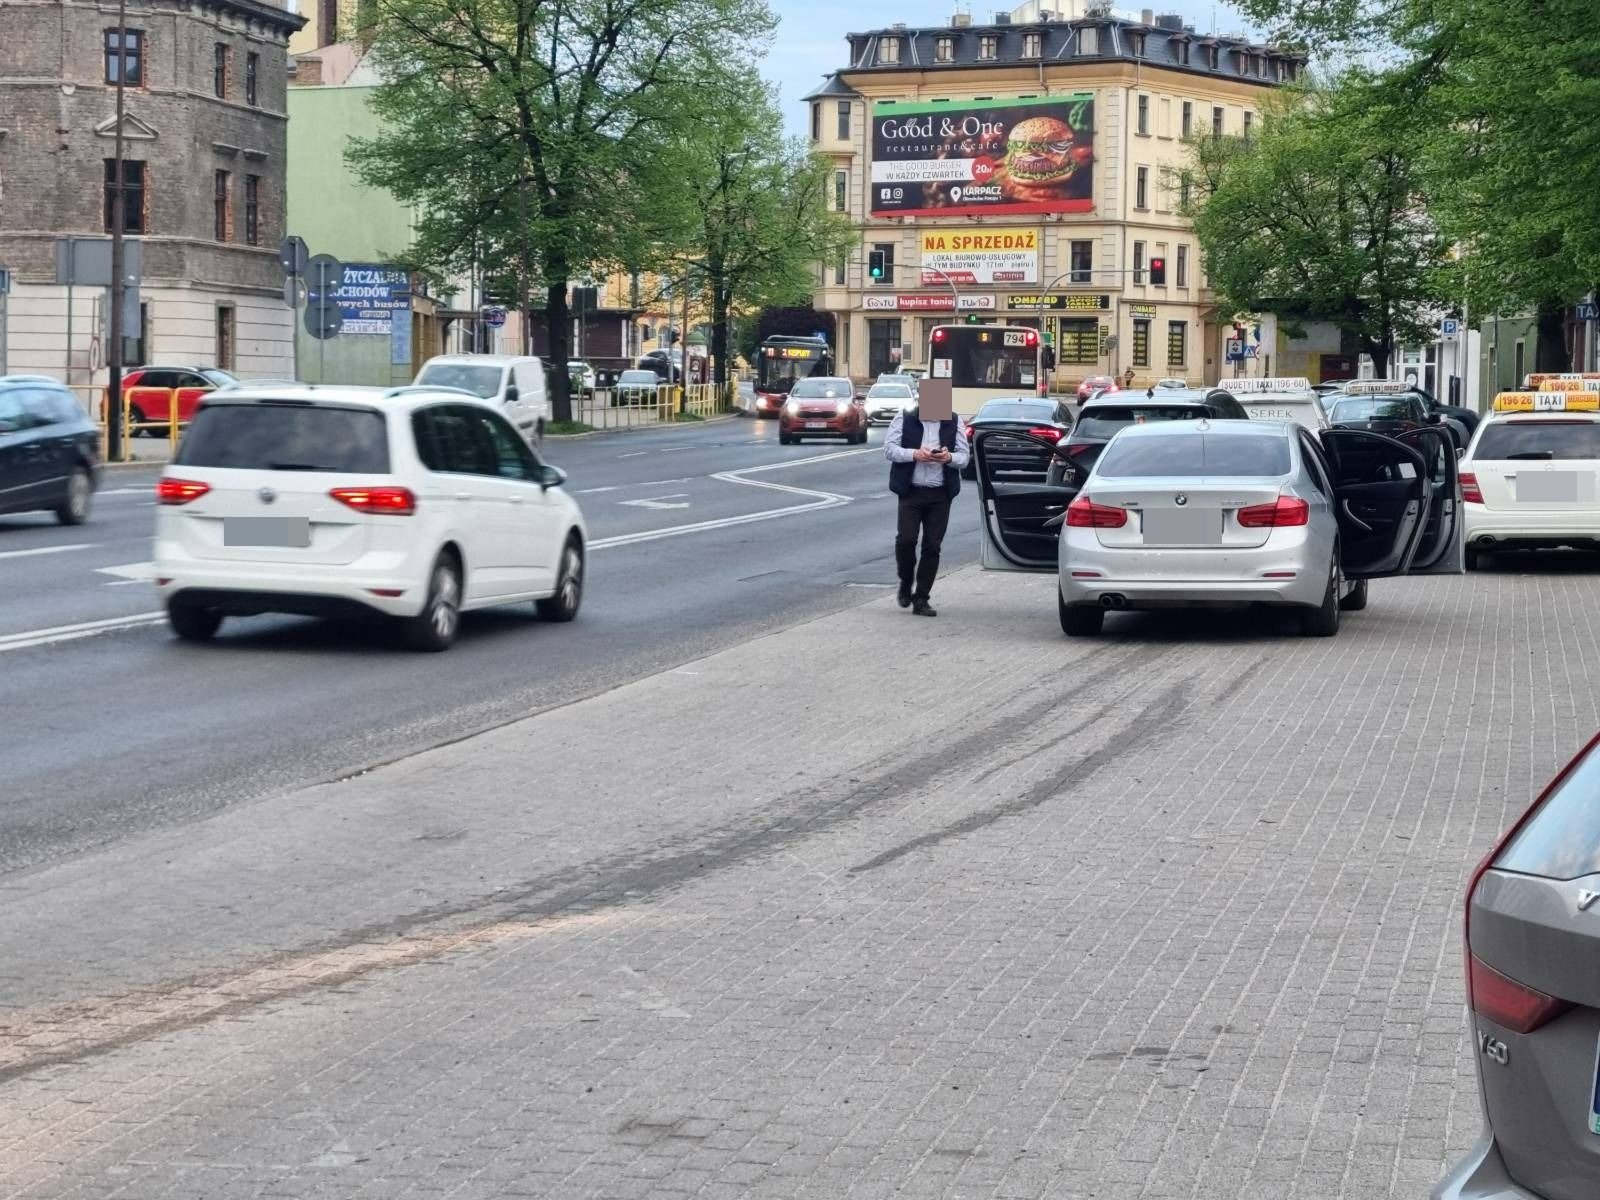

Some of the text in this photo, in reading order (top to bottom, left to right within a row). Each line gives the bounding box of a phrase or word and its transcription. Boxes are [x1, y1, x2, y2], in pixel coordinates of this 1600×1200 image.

[881, 116, 1003, 139] Good & One
[890, 161, 962, 171] THE GOOD BURGER
[922, 170, 965, 179] CZWARTEK
[962, 186, 1002, 196] KARPACZ
[925, 231, 1034, 250] NA SPRZEDAŻ
[932, 254, 953, 262] LOKAL
[336, 299, 409, 309] wych busów
[899, 297, 928, 308] kupisz
[1008, 296, 1058, 304] LOMBARD
[1446, 322, 1455, 332] P
[1005, 334, 1025, 343] 794
[1223, 382, 1251, 391] SUDETY
[1256, 381, 1273, 390] TAXI
[1588, 382, 1600, 391] TA
[1502, 395, 1518, 405] 196
[1520, 395, 1533, 405] 26
[1537, 395, 1562, 405] TAXI
[1250, 408, 1293, 419] SEREK
[1477, 1030, 1508, 1064] V60
